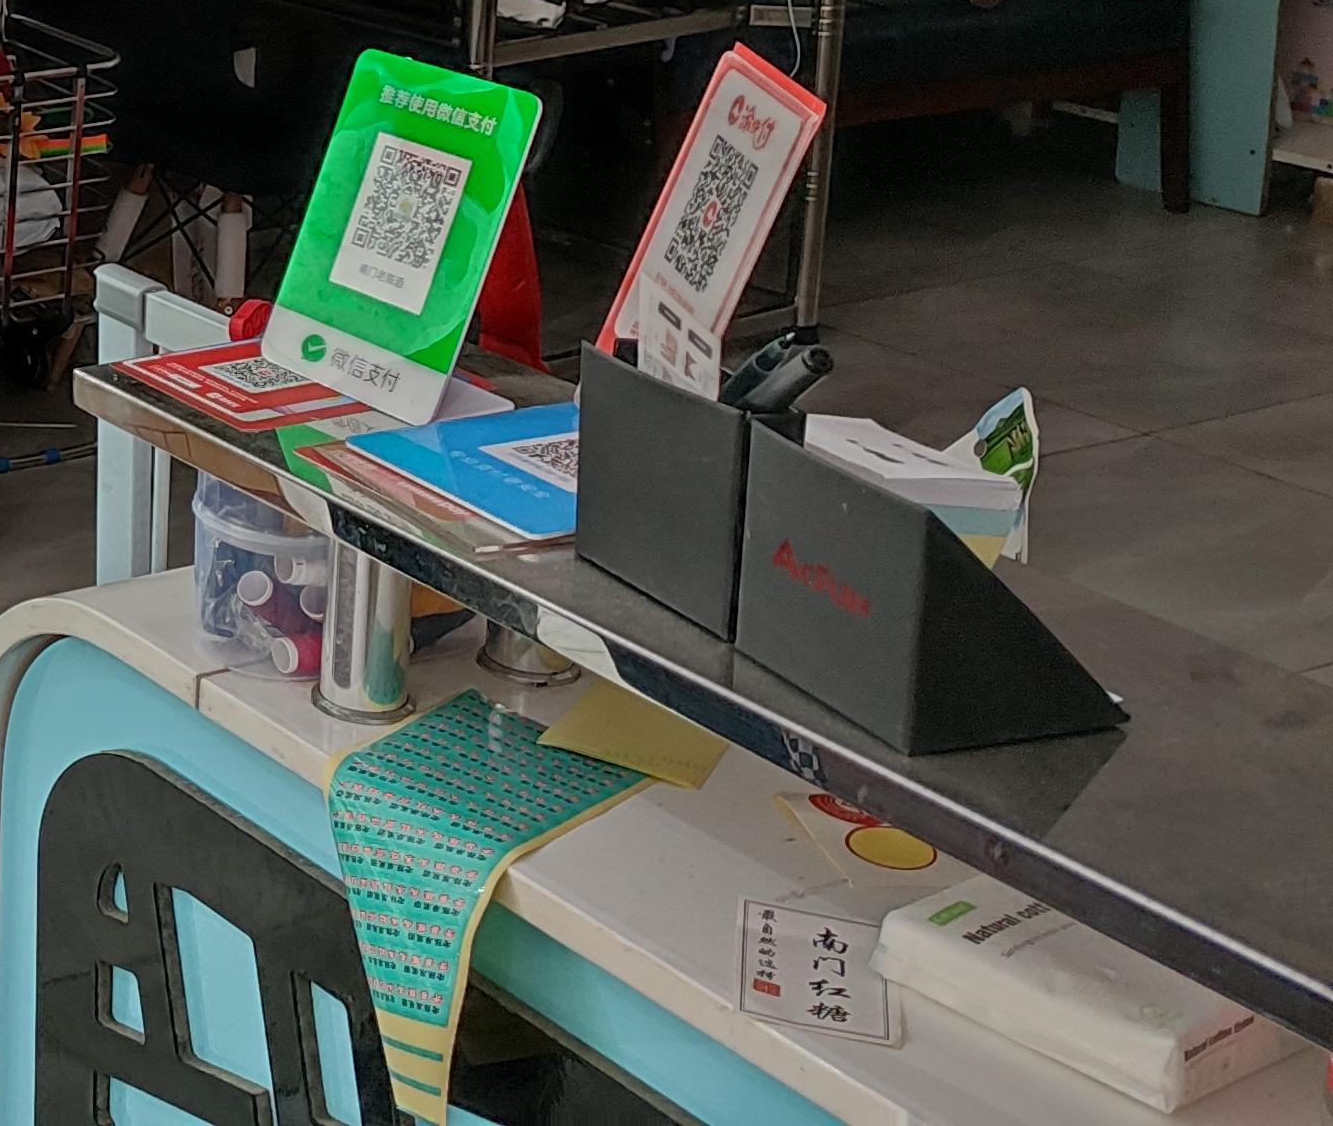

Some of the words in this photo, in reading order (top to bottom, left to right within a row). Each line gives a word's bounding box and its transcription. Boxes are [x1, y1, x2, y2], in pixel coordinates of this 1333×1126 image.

[378, 84, 498, 137] 推荐使用微信支付
[329, 347, 401, 393] 微信支付
[962, 913, 1022, 946] Natural
[806, 926, 854, 1024] 南门红糖
